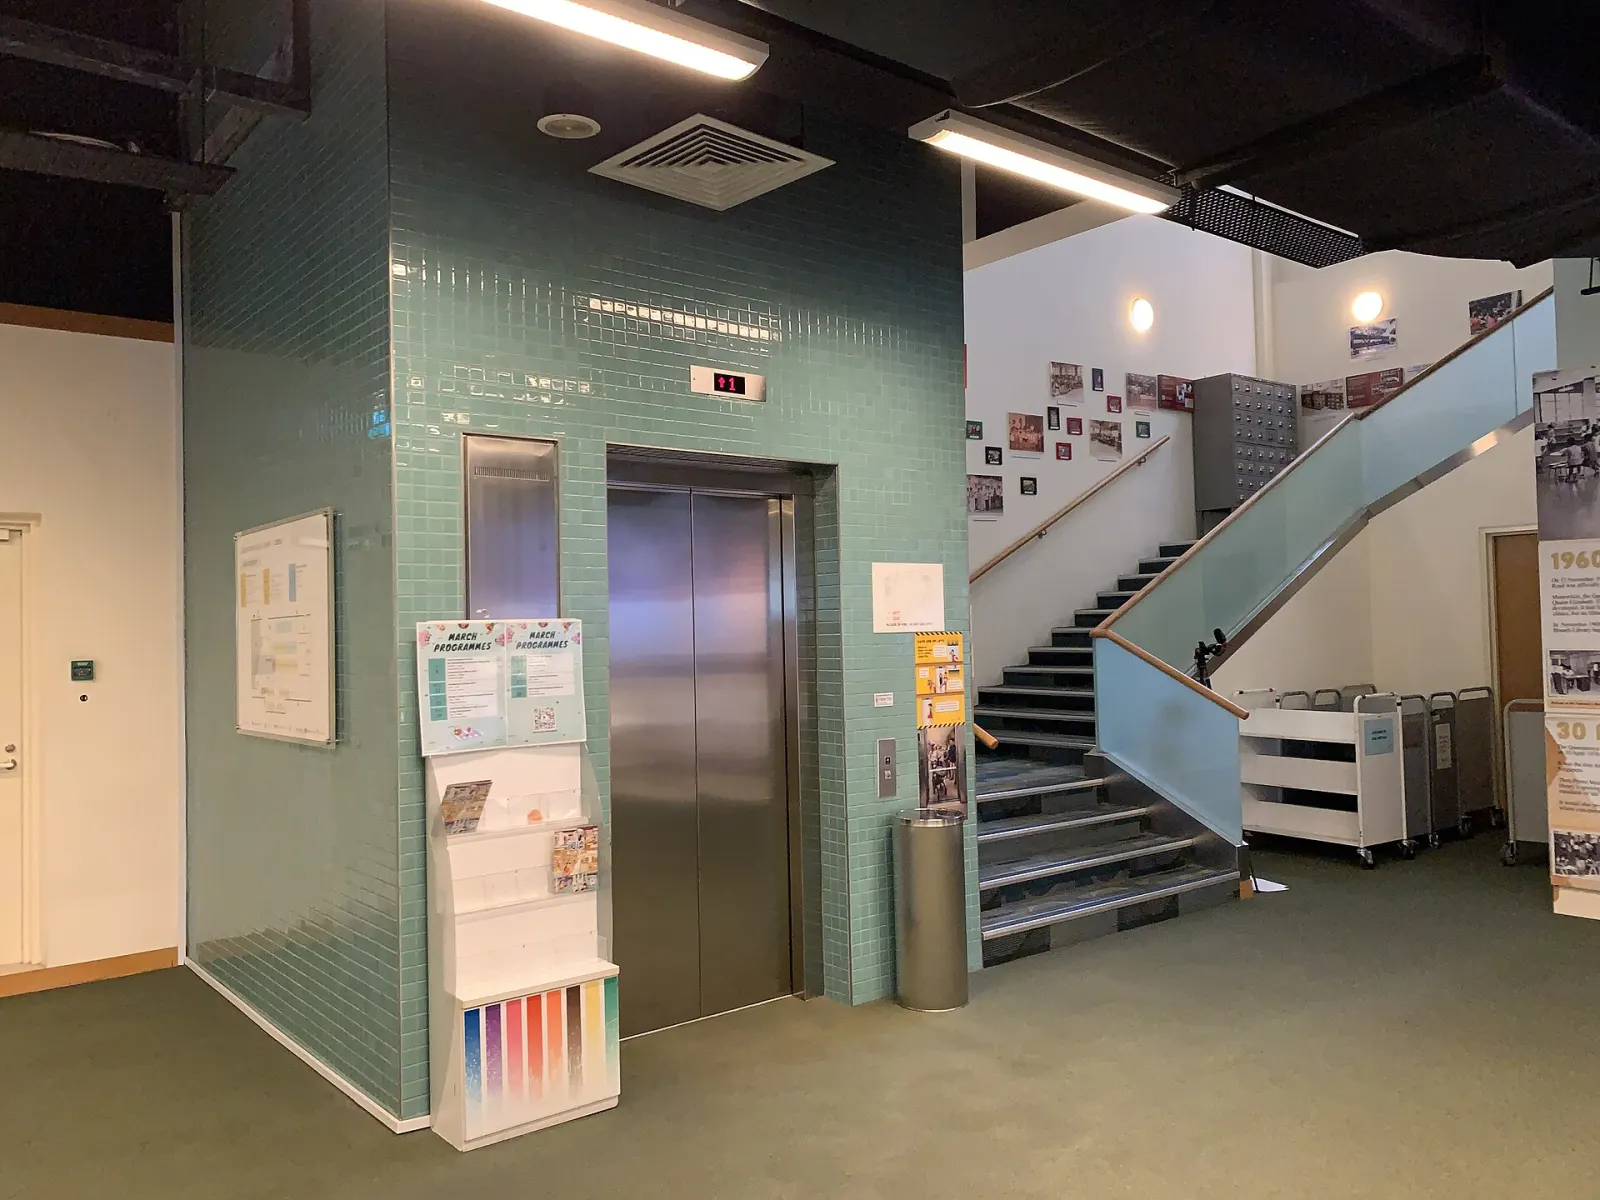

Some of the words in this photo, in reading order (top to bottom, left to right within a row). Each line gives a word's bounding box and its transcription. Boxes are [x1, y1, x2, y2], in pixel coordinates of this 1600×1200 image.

[728, 377, 736, 391] 1
[448, 632, 478, 641] MARCH
[529, 631, 556, 639] MARCH
[433, 642, 492, 652] PROGRAMMES
[515, 640, 568, 650] PROGRAMMES
[1556, 721, 1586, 740] 30
